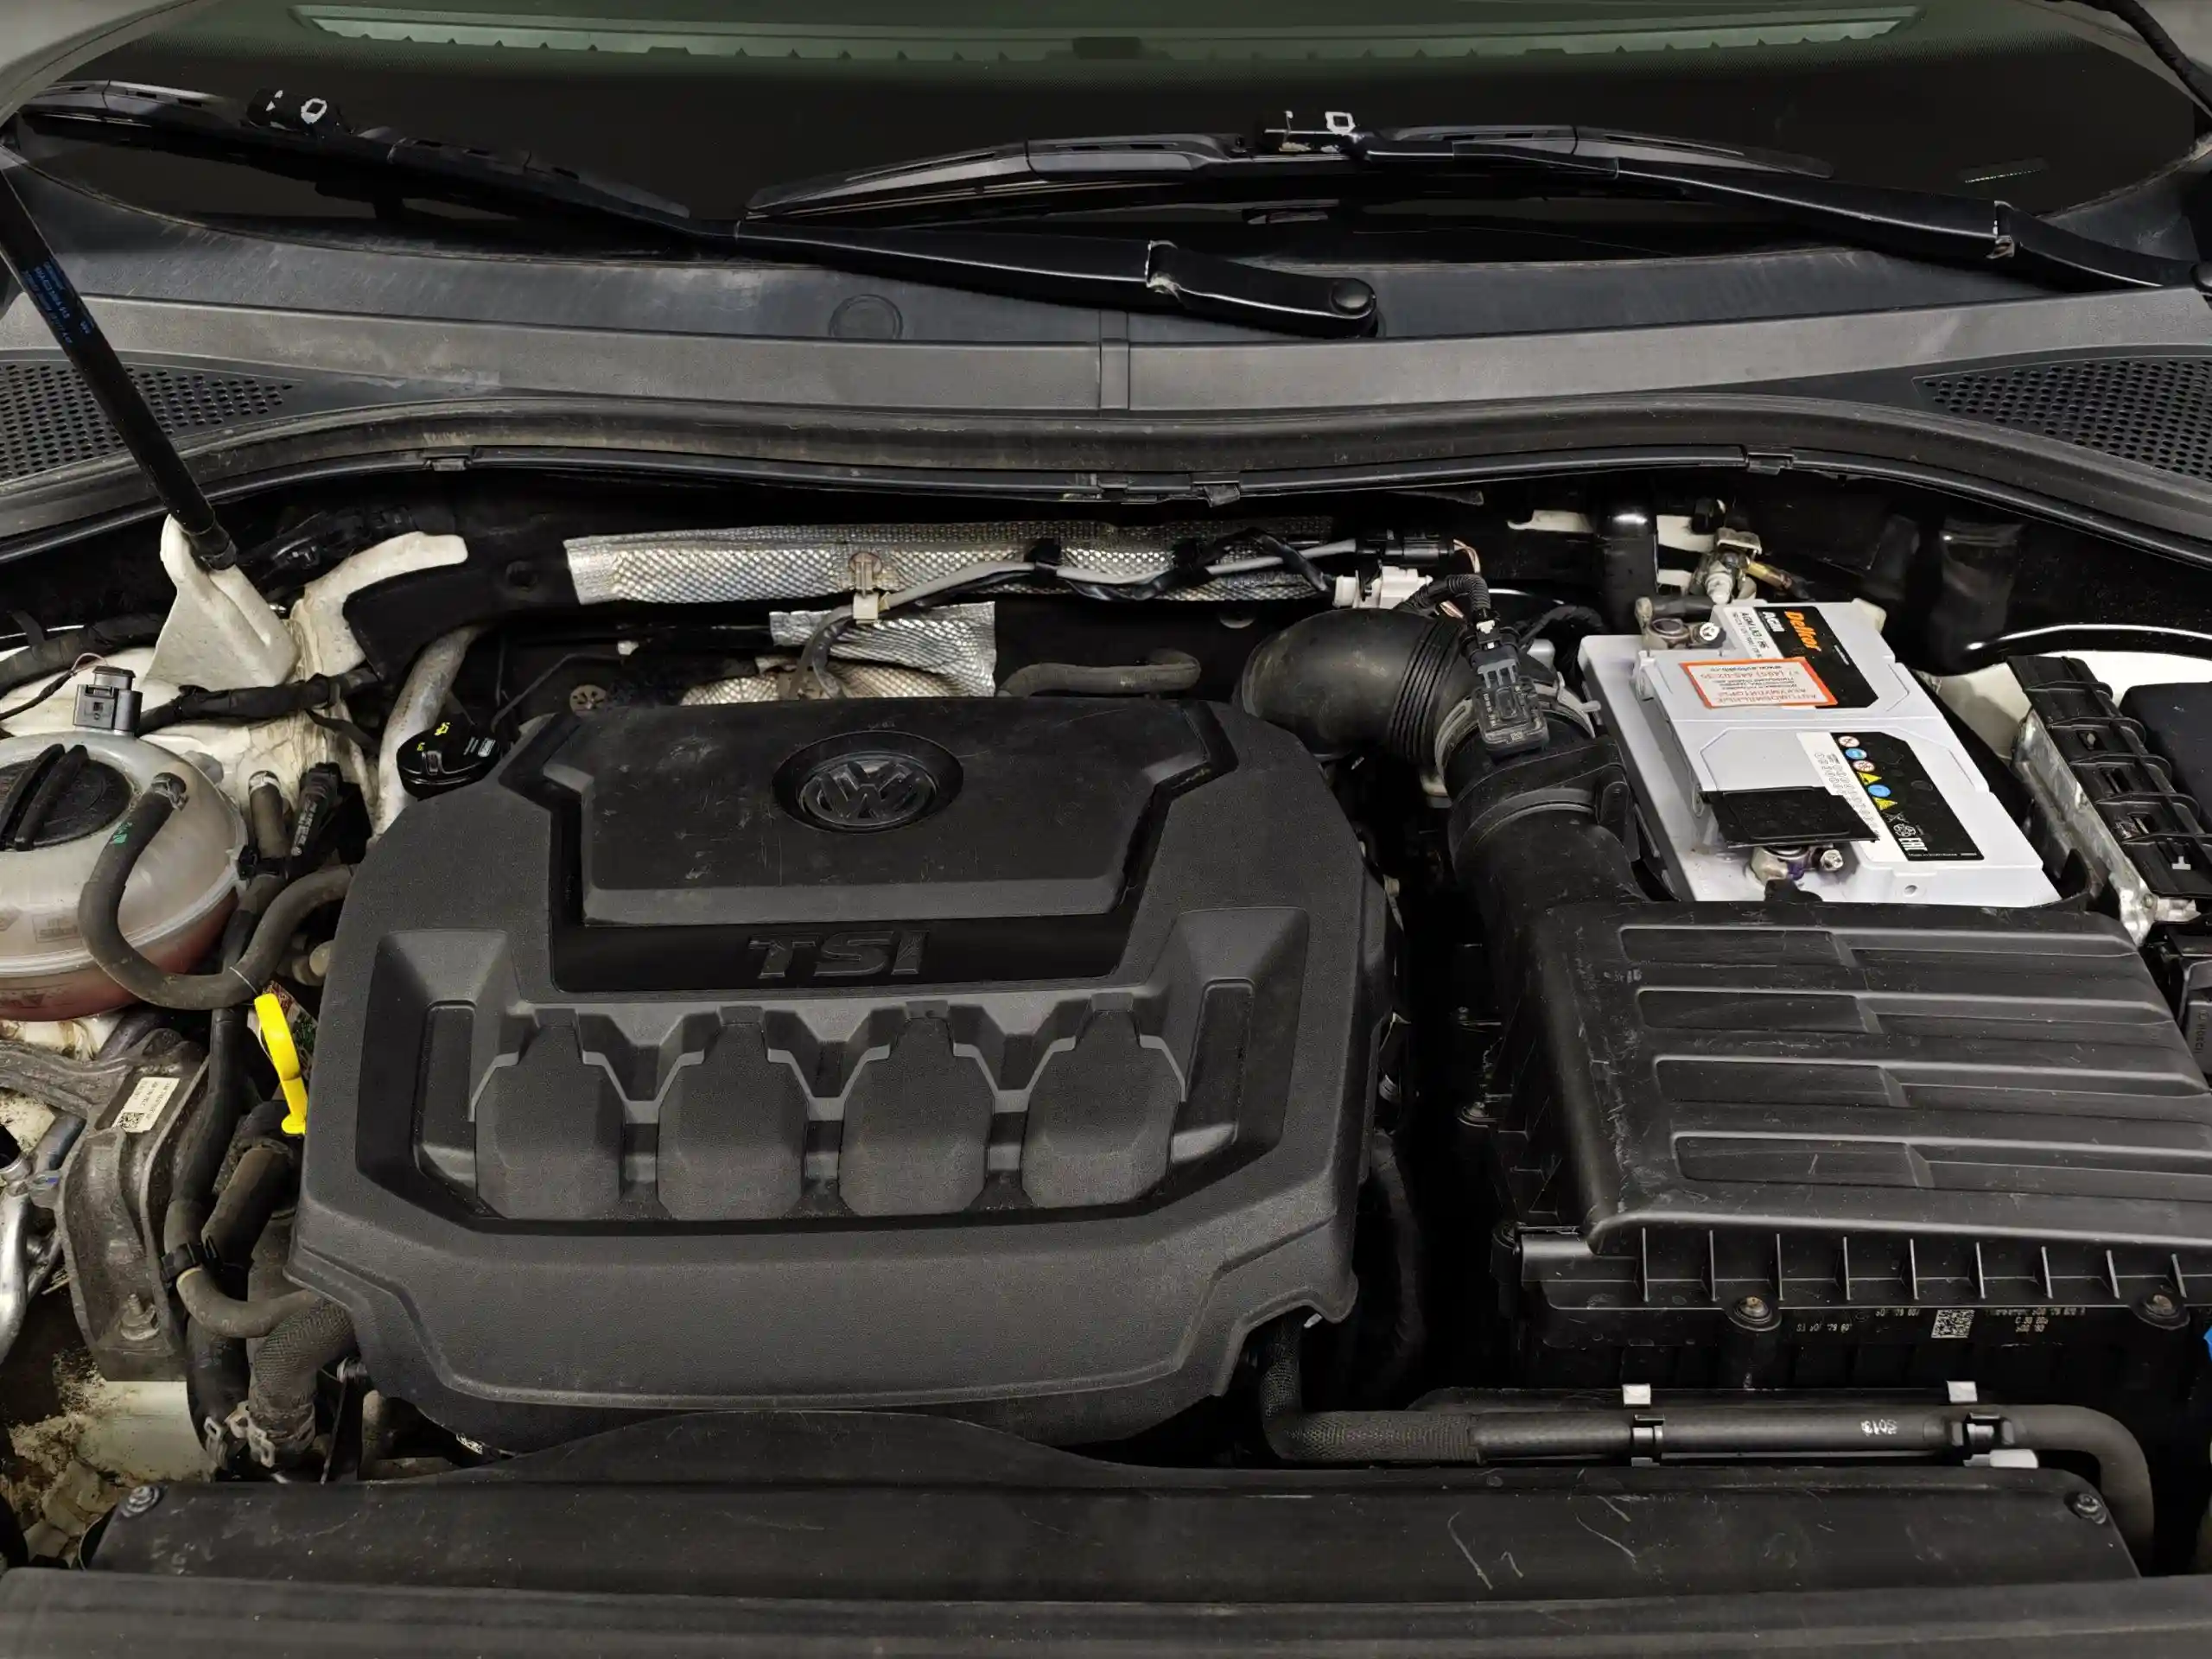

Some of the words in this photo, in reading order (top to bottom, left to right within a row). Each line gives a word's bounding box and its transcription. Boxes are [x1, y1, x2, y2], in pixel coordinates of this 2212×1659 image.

[1762, 611, 1785, 632] AGM
[1784, 610, 1822, 652] Delkor
[748, 930, 931, 979] TSI
